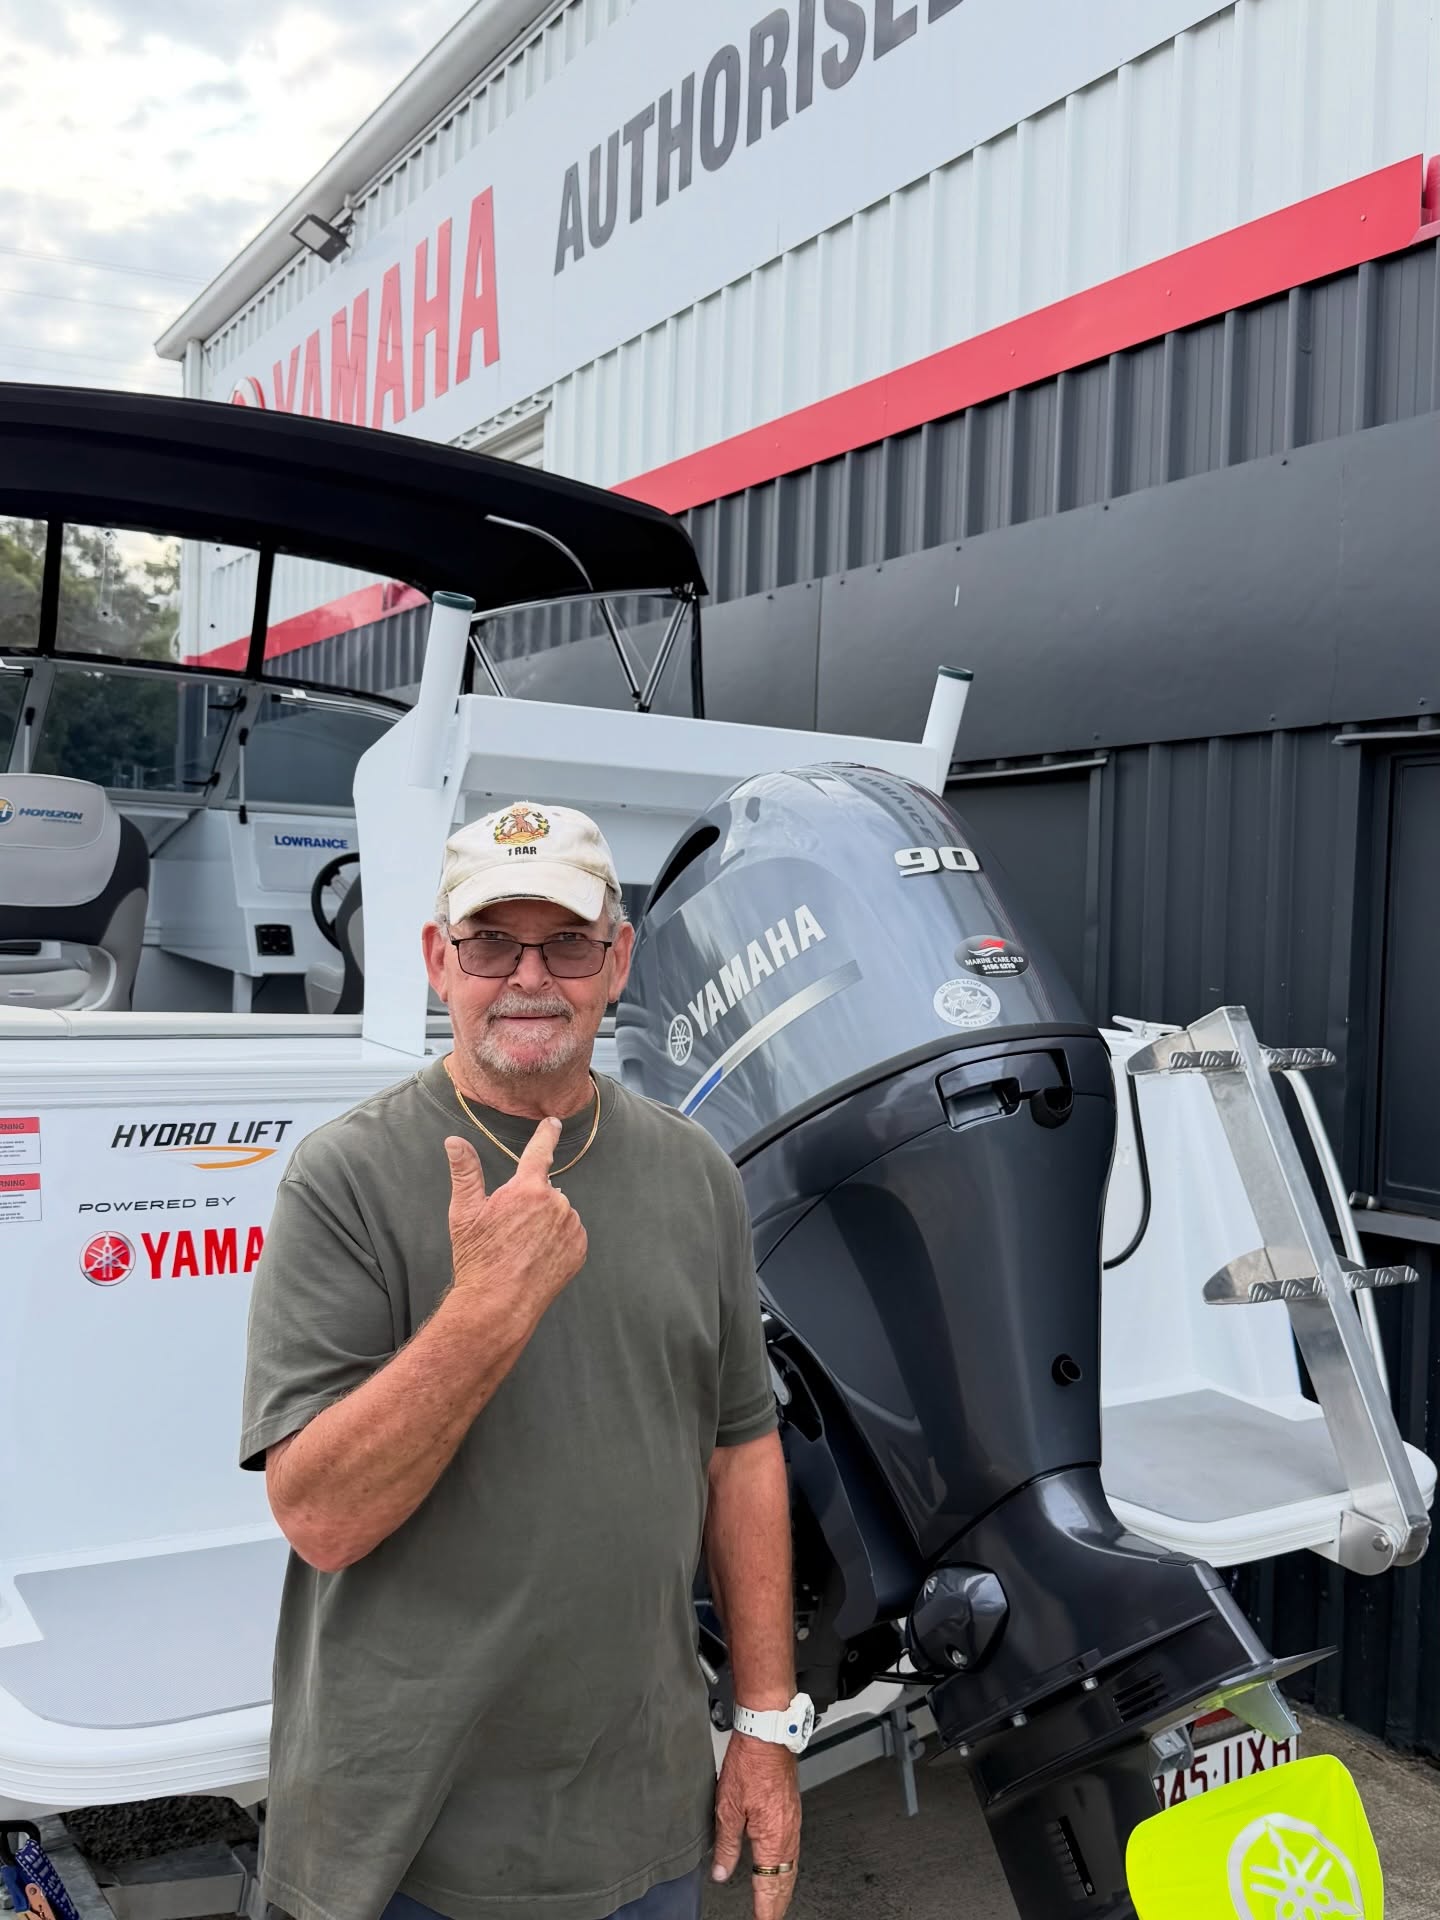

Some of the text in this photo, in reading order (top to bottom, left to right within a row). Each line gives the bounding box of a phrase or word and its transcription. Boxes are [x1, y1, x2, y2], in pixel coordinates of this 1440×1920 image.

[553, 0, 964, 276] AUTHORIS
[19, 808, 83, 820] HORIZON
[274, 835, 348, 849] LOWRANCE
[514, 846, 537, 856] RAR
[894, 846, 980, 877] 90
[687, 904, 827, 1037] YAMAHA
[965, 957, 992, 966] MARINE
[1010, 956, 1024, 964] QLD
[111, 1120, 293, 1148] HYDRO LIFT
[78, 1197, 236, 1213] POWERED BY
[140, 1226, 264, 1280] YAMA
